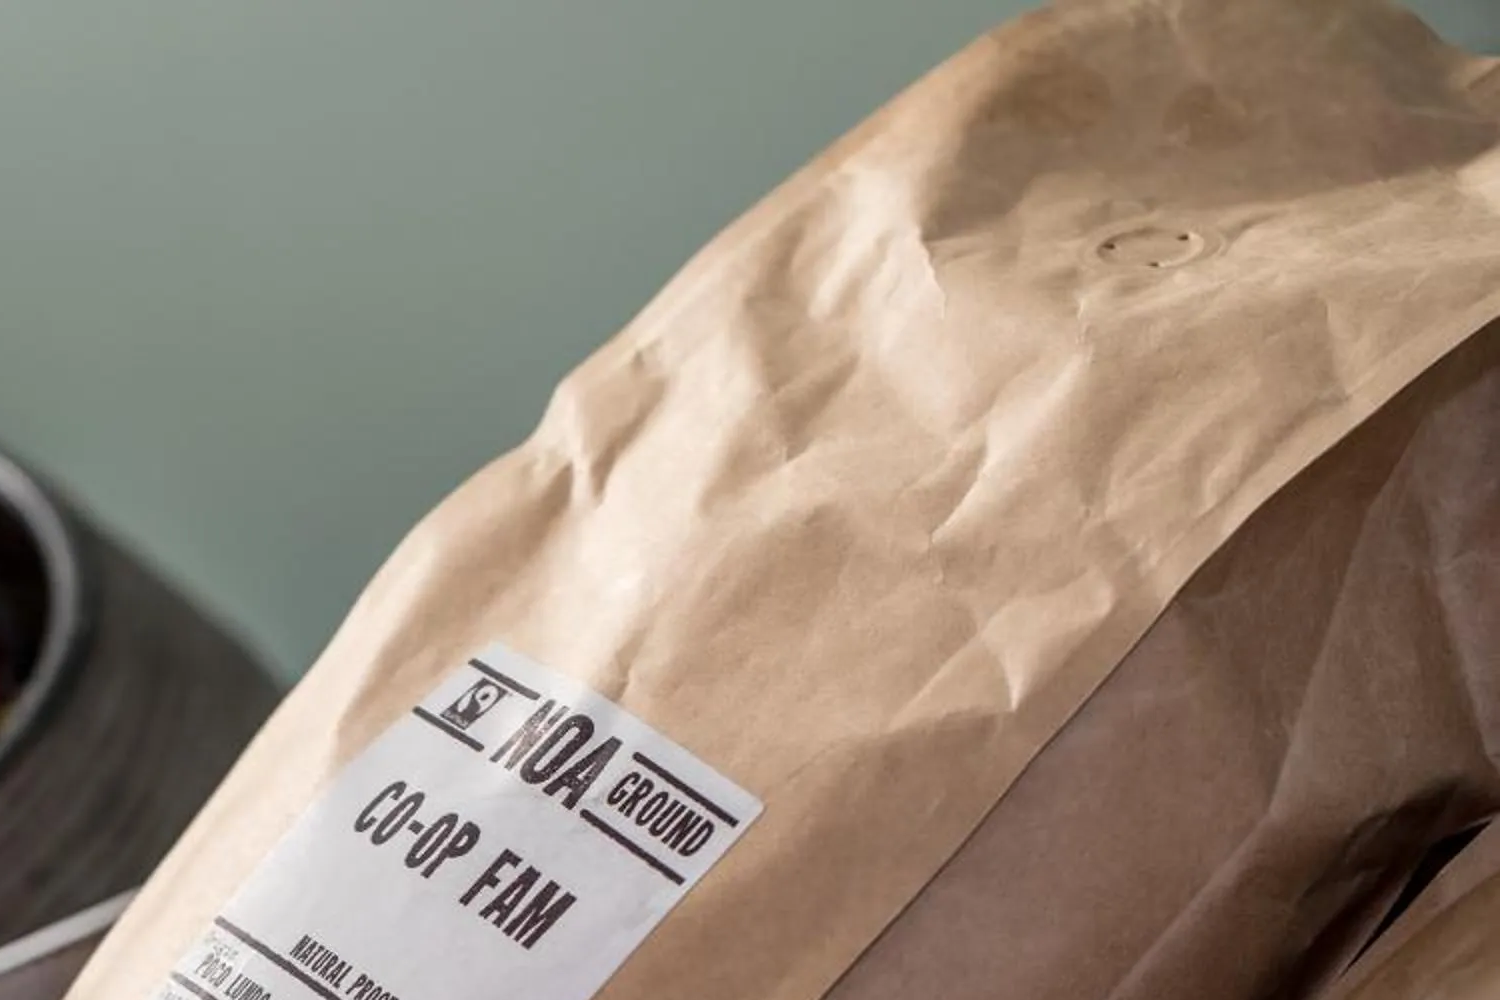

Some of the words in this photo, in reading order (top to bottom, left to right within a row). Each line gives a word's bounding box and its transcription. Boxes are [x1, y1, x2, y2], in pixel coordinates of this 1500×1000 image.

[489, 699, 622, 810] NOA
[607, 771, 714, 857] GROUND
[354, 781, 481, 879] CO-OP
[459, 848, 577, 950] FAM
[289, 934, 352, 988] NATURAL
